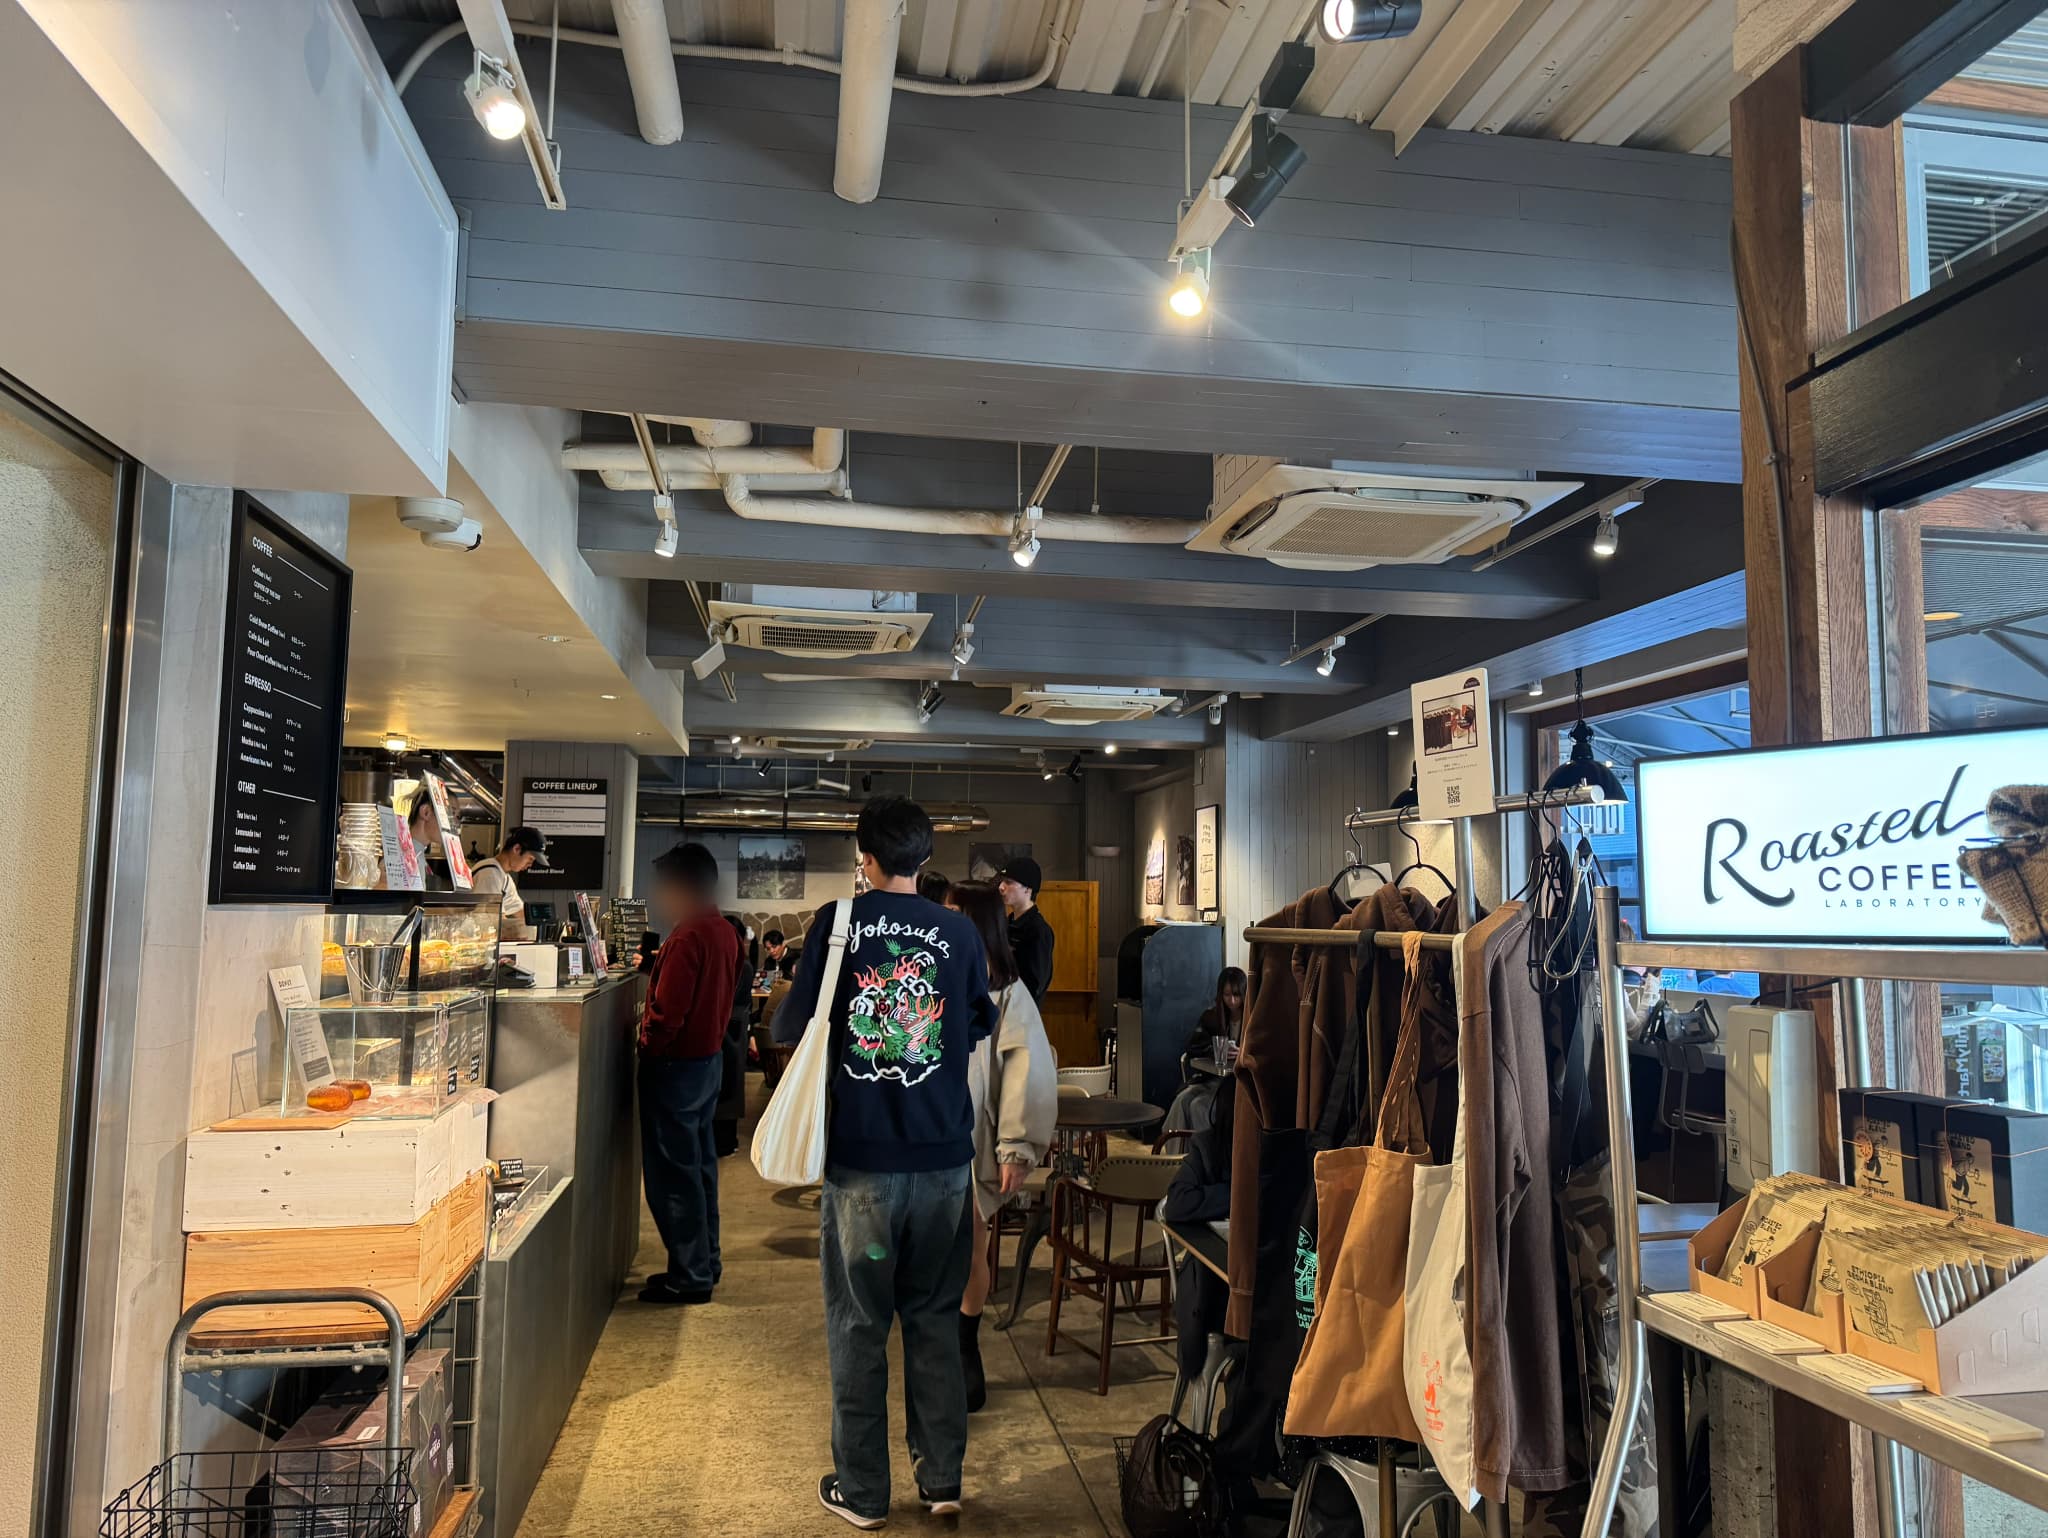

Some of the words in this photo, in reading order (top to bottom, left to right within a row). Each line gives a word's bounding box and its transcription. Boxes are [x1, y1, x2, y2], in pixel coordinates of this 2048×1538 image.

[252, 536, 273, 558] COFFEE
[245, 672, 272, 693] ESPRESSO
[237, 780, 256, 795] OTHER
[532, 782, 565, 790] COFFEE
[567, 782, 598, 790] LINEUP
[1703, 763, 1985, 907] Roasted
[1824, 897, 1982, 908] LABORATORY
[1851, 1265, 1886, 1283] ETHIOPIA
